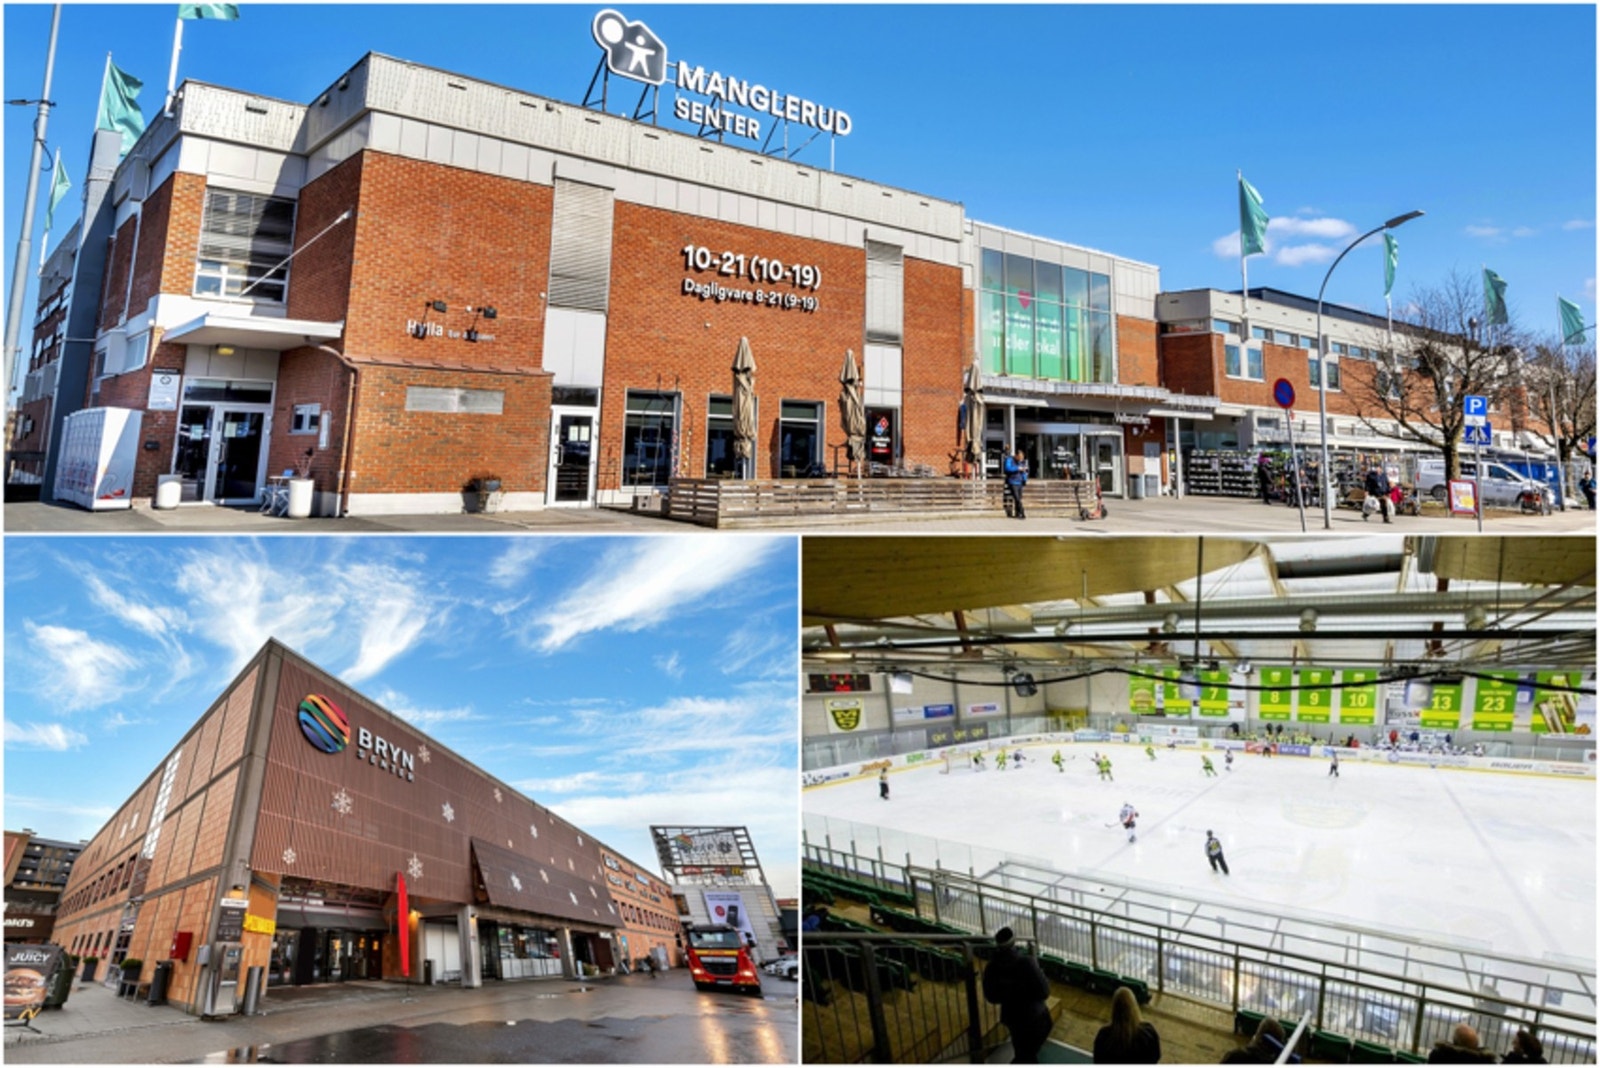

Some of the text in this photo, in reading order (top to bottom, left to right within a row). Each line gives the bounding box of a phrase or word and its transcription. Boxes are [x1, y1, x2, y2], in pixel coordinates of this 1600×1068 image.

[676, 60, 852, 136] MANGLERUD
[675, 98, 761, 140] SENTER
[683, 244, 822, 290] 10-21 (10-19)
[683, 278, 821, 312] Dagligvare 8-21 (9-19)
[1469, 398, 1482, 414] P
[1209, 686, 1219, 701] 7
[1270, 690, 1280, 704] 8
[1309, 691, 1319, 706] 9
[1349, 693, 1368, 707] 10
[1431, 695, 1452, 710] 13
[1482, 695, 1505, 711] 23
[358, 726, 414, 772] BRYN
[10, 952, 51, 963] JUICY
